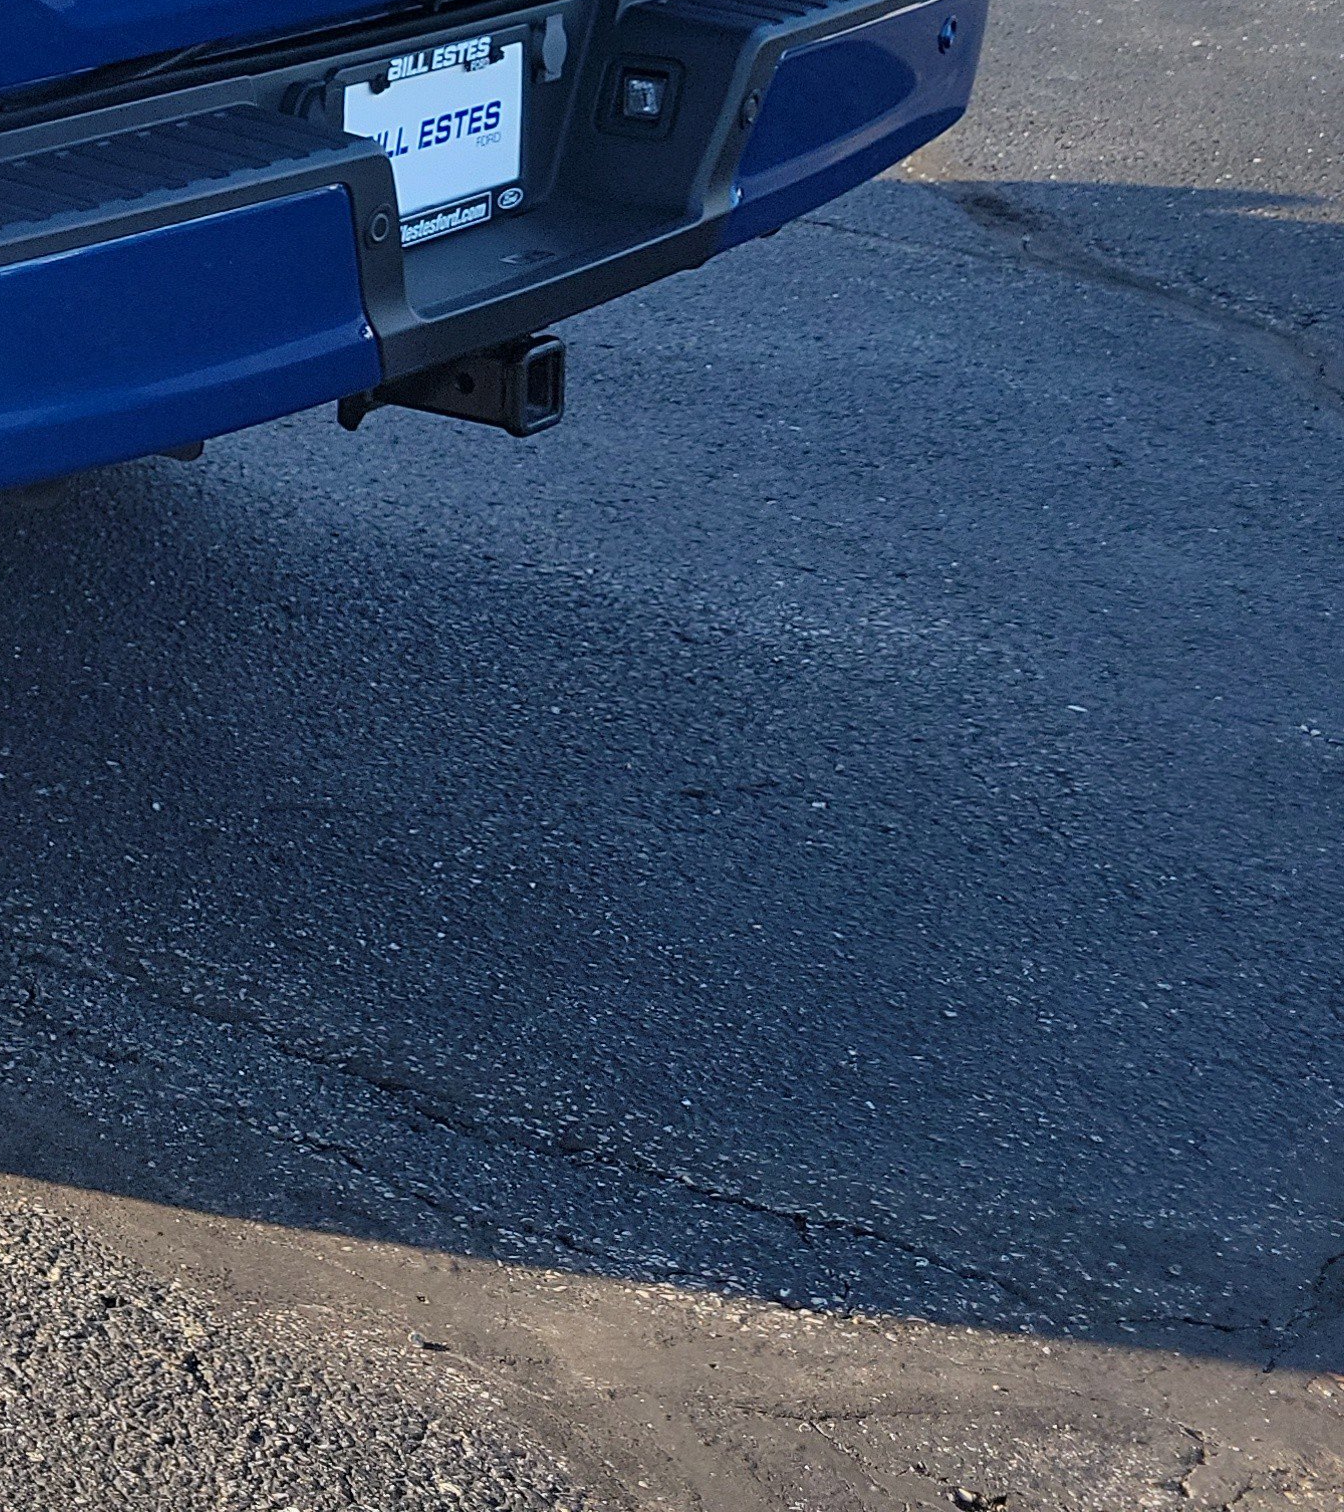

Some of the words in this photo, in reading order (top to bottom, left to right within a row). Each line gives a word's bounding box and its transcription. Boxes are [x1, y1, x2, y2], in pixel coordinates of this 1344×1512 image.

[387, 53, 429, 81] BILL
[431, 36, 491, 70] ESTES
[417, 99, 502, 150] ESTES
[475, 131, 502, 148] FORD
